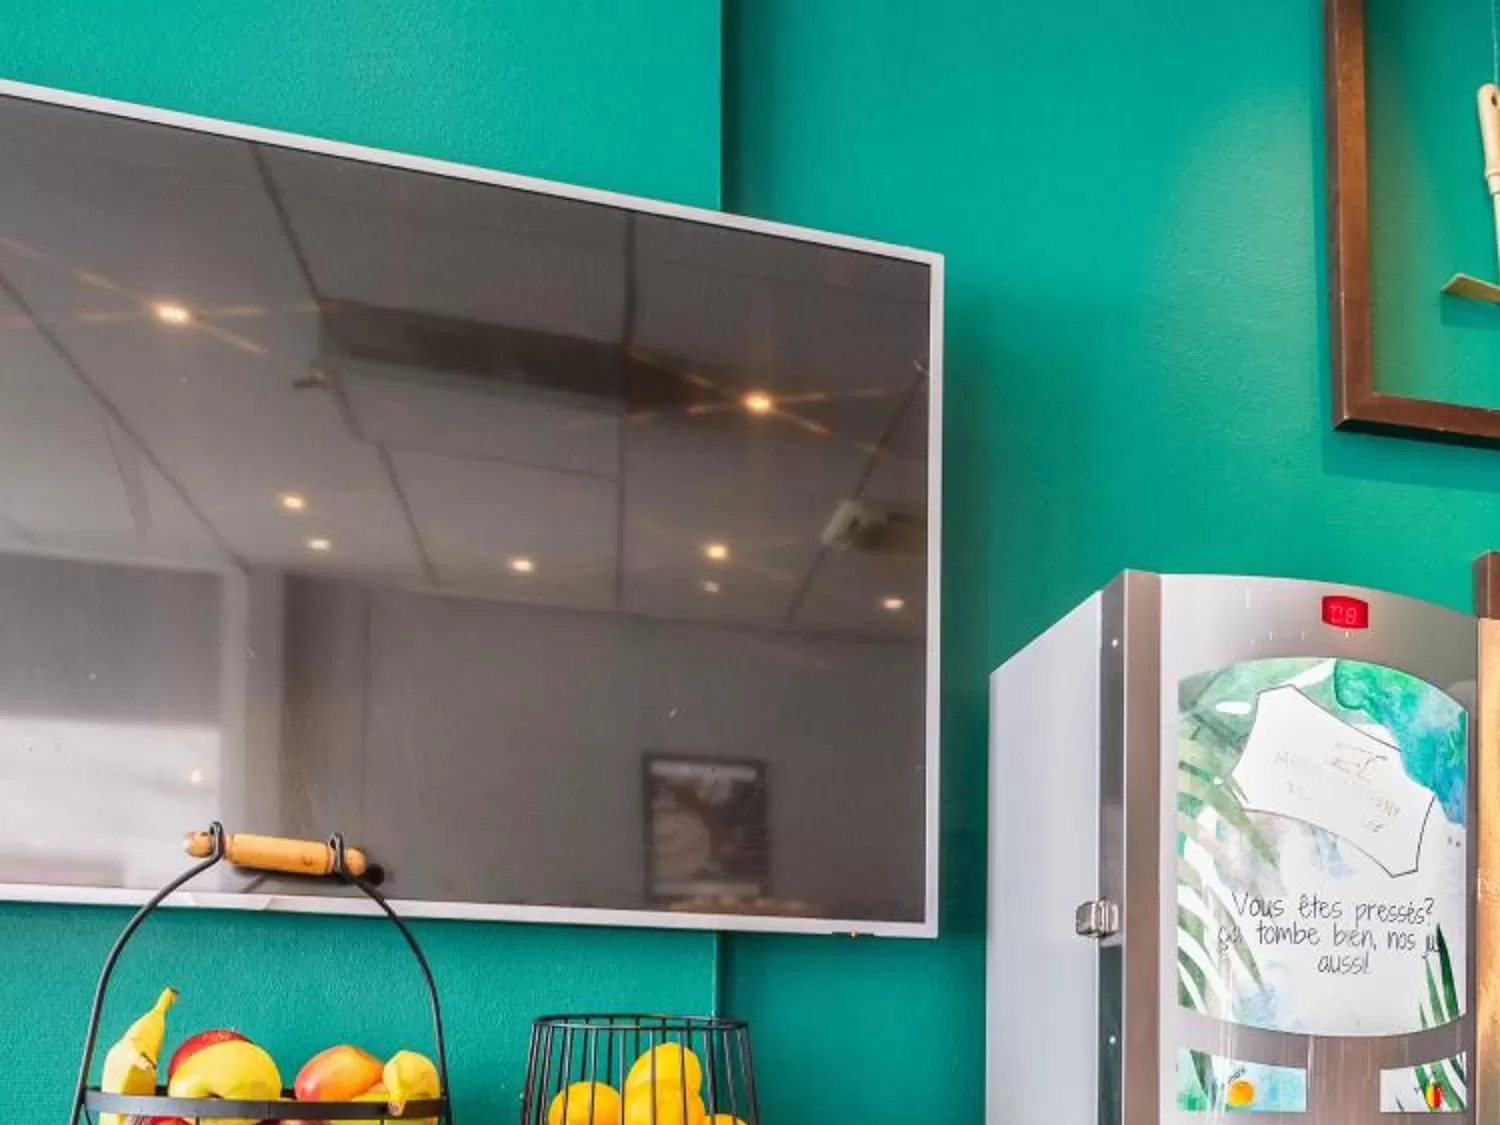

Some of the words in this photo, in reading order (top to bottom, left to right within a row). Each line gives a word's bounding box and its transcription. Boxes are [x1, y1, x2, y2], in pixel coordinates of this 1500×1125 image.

[1231, 891, 1285, 919] Vous
[1298, 893, 1343, 919] êtes
[1256, 919, 1320, 945] tombe
[1387, 930, 1416, 951] nos
